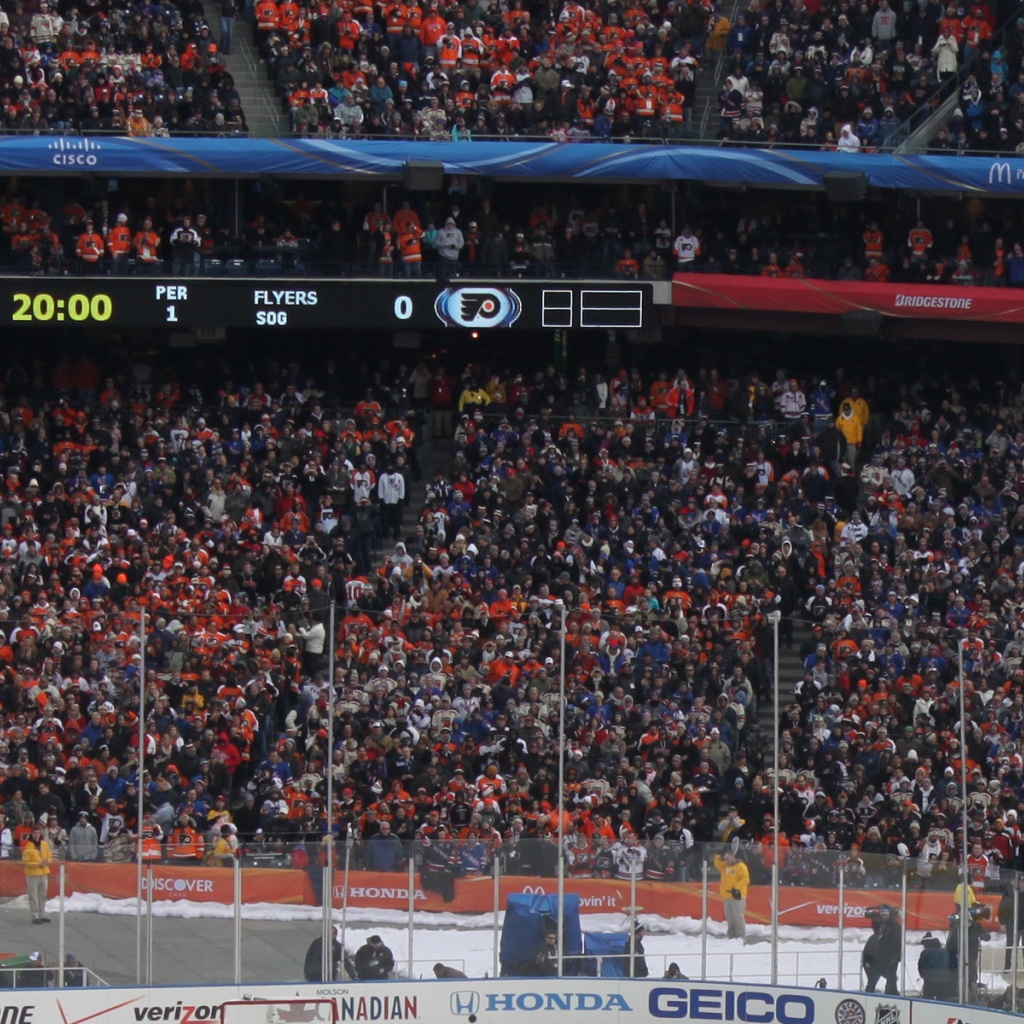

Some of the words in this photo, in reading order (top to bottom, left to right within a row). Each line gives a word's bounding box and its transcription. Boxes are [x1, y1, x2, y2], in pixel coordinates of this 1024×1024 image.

[53, 154, 98, 166] CISCO
[155, 285, 188, 300] PER
[253, 290, 318, 306] FLYERS
[12, 293, 113, 321] 20:00
[394, 296, 413, 320] 0
[895, 294, 972, 310] BRIDGESTONE
[166, 305, 178, 322] 1
[256, 311, 288, 326] SOG
[141, 878, 214, 892] DISCOVER
[349, 887, 427, 900] HONDA
[607, 896, 616, 907] it
[316, 988, 349, 996] MOLSON
[316, 995, 418, 1021] CANADIAN
[485, 993, 633, 1012] HONDA
